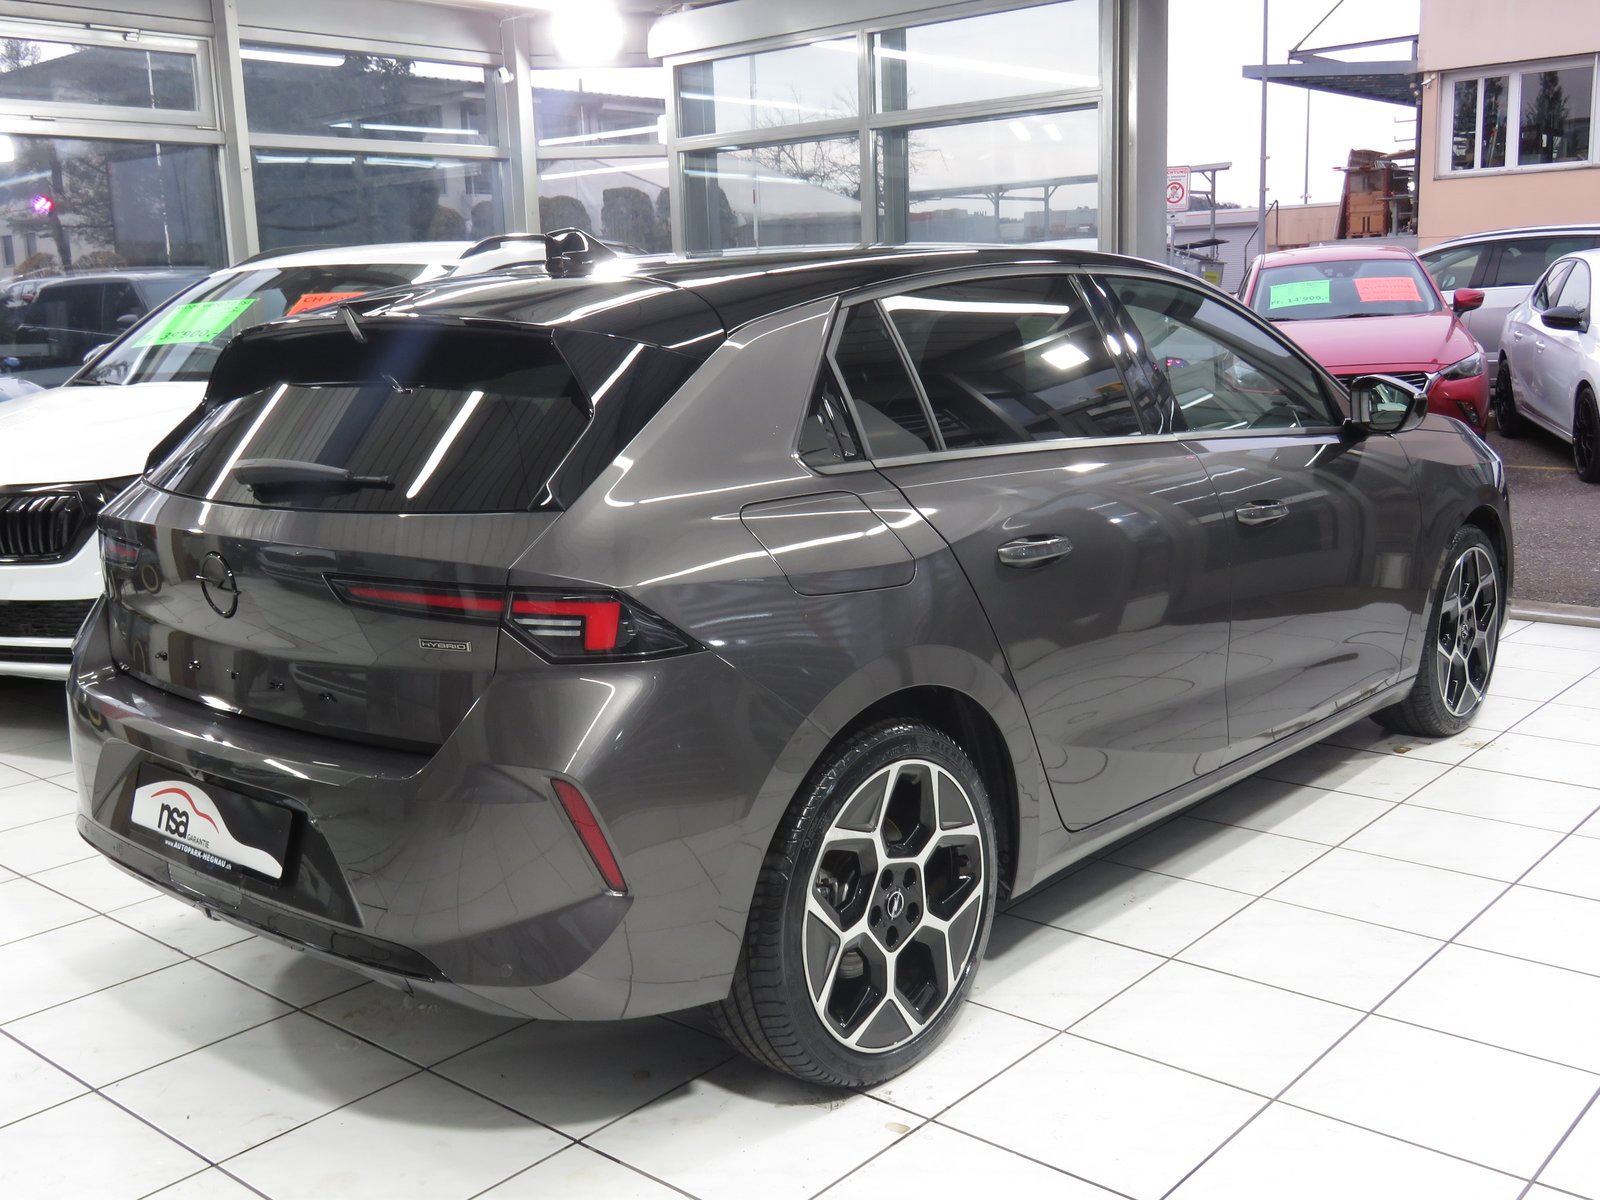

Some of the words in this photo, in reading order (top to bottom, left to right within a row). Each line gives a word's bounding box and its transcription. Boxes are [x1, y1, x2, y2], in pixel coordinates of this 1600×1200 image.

[421, 641, 466, 650] HYBRID
[158, 803, 189, 839] nsa
[187, 834, 210, 848] GARANTIE
